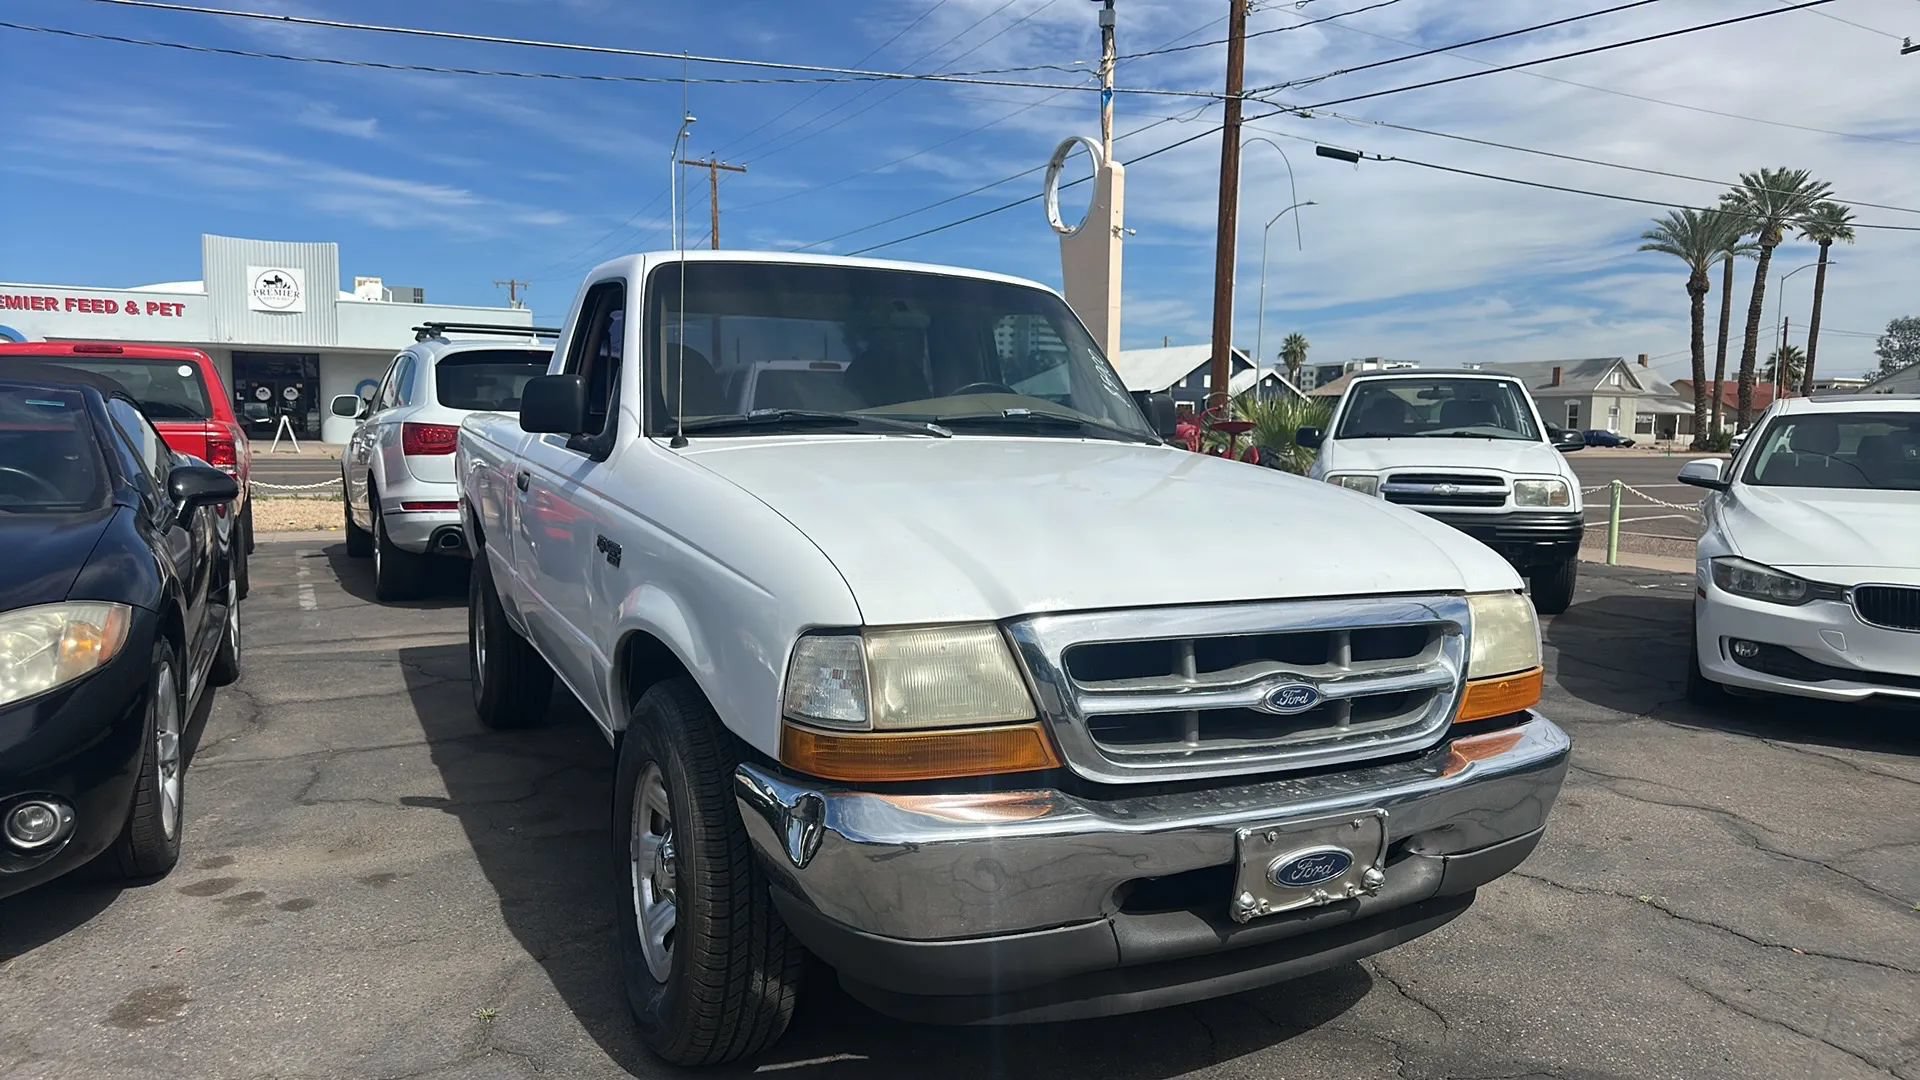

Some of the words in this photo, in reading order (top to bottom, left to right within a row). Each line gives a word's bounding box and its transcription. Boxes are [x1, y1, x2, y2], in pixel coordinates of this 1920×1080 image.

[253, 289, 299, 298] PREMIER
[65, 297, 119, 314] FEED
[125, 300, 140, 315] &
[146, 301, 186, 317] PET
[1276, 689, 1308, 705] Ford
[1291, 856, 1335, 880] Ford
